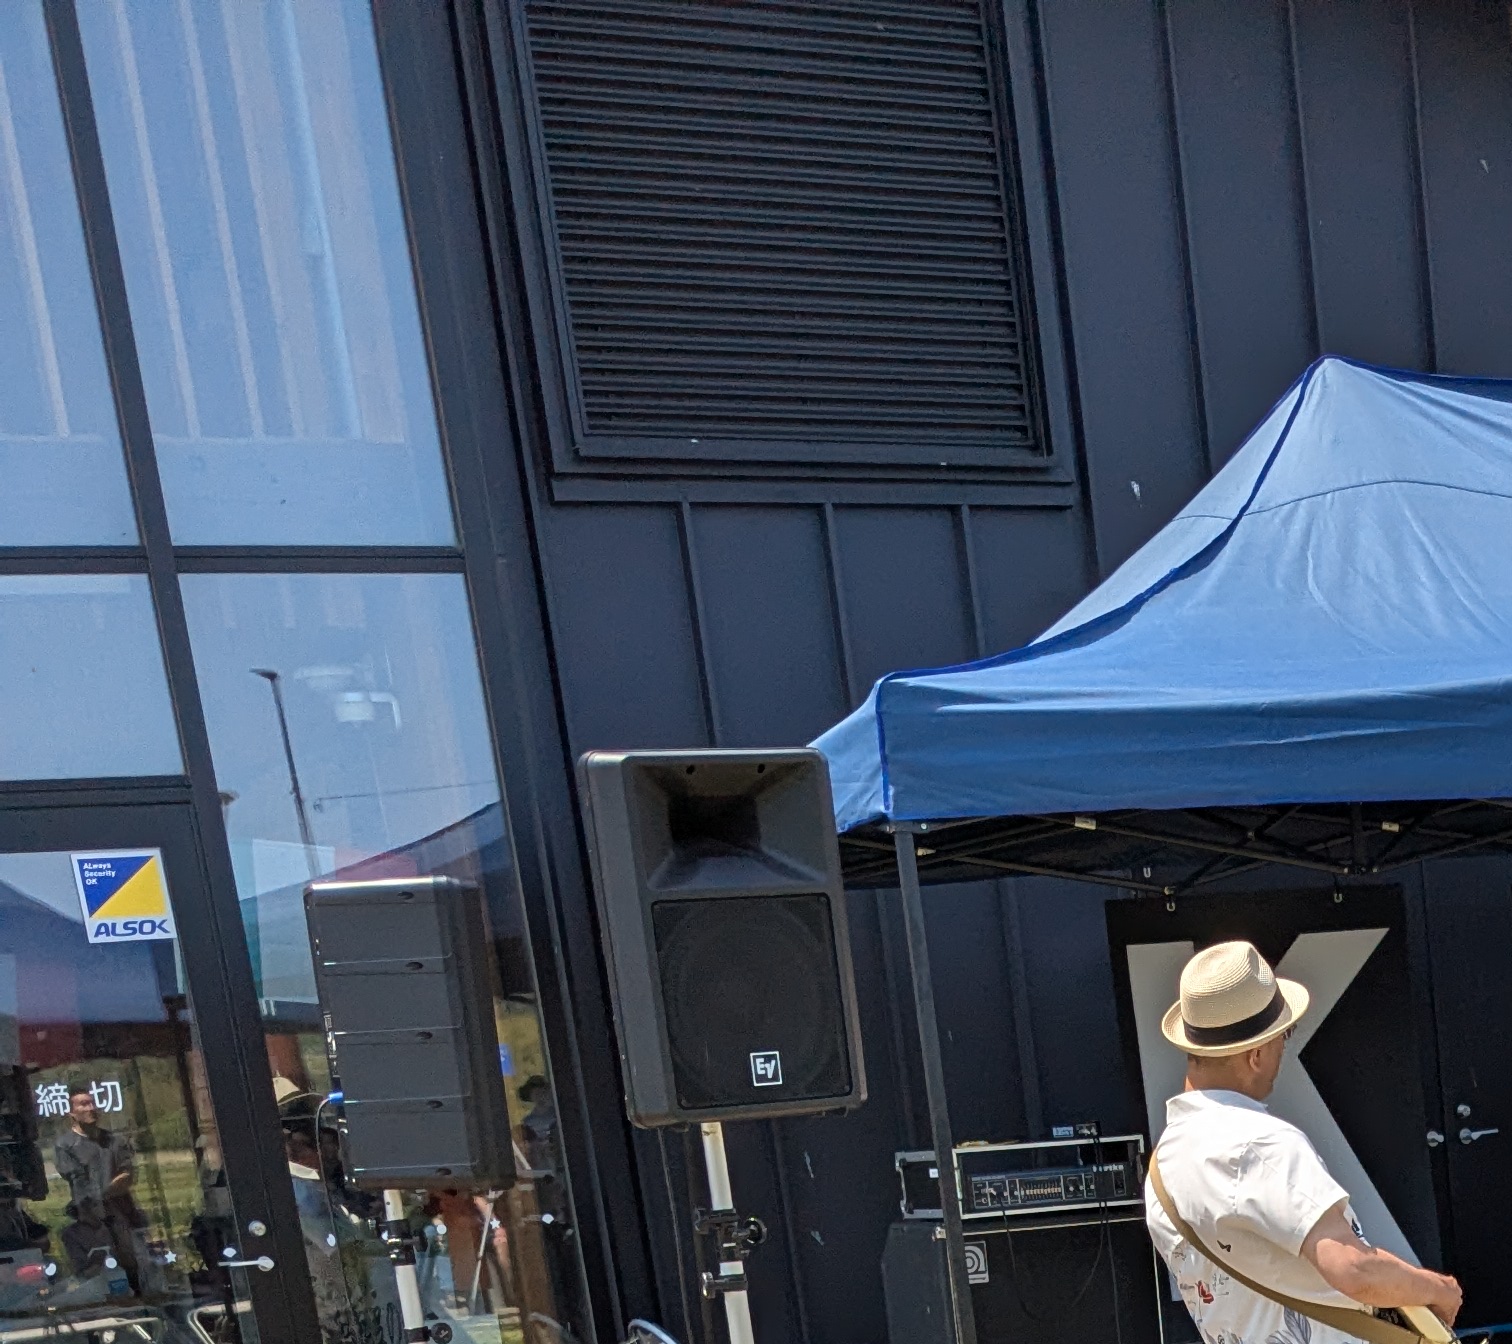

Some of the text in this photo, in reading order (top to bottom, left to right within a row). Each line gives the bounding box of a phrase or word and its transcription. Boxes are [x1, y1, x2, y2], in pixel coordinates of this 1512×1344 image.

[86, 878, 98, 886] OK
[93, 919, 171, 938] ALSOK
[35, 1080, 123, 1118] 締切
